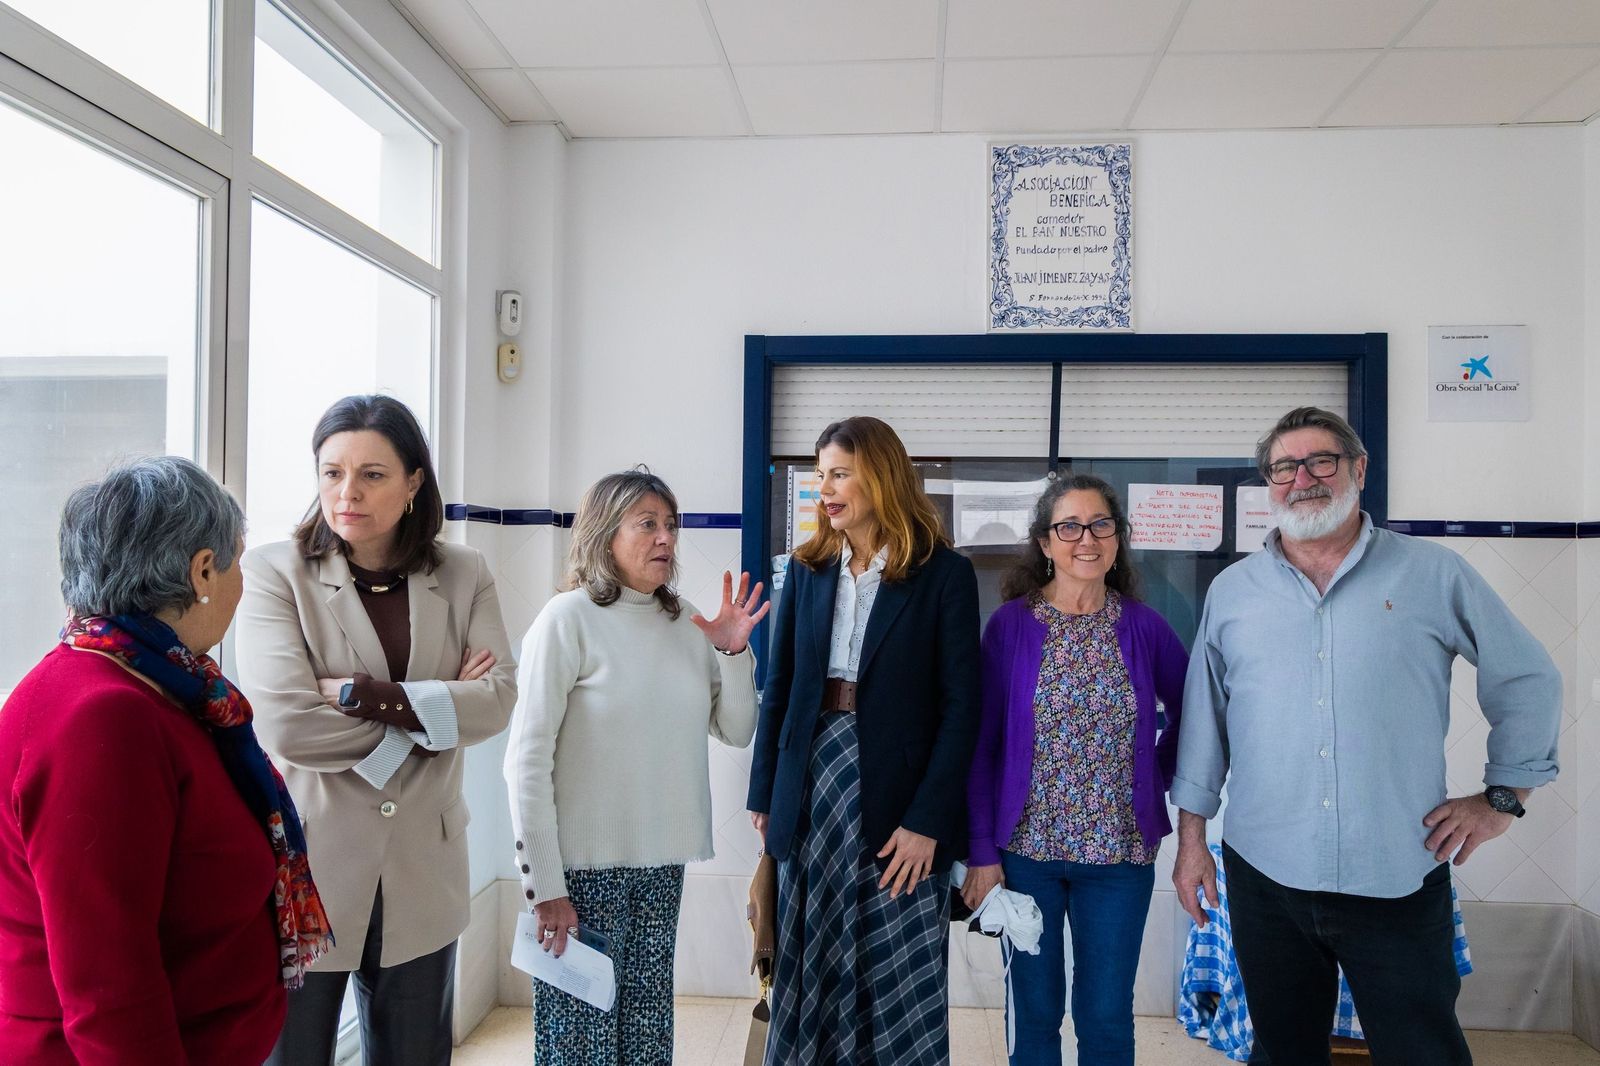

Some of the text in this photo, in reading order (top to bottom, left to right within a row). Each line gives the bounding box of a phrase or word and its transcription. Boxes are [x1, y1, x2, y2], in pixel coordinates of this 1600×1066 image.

[1015, 225, 1107, 238] EL PAN NUESTRO
[1073, 245, 1081, 255] el
[1083, 245, 1108, 257] padre
[1079, 272, 1110, 287] ZAYAS
[1436, 383, 1457, 392] Obra
[1459, 383, 1482, 392] Social
